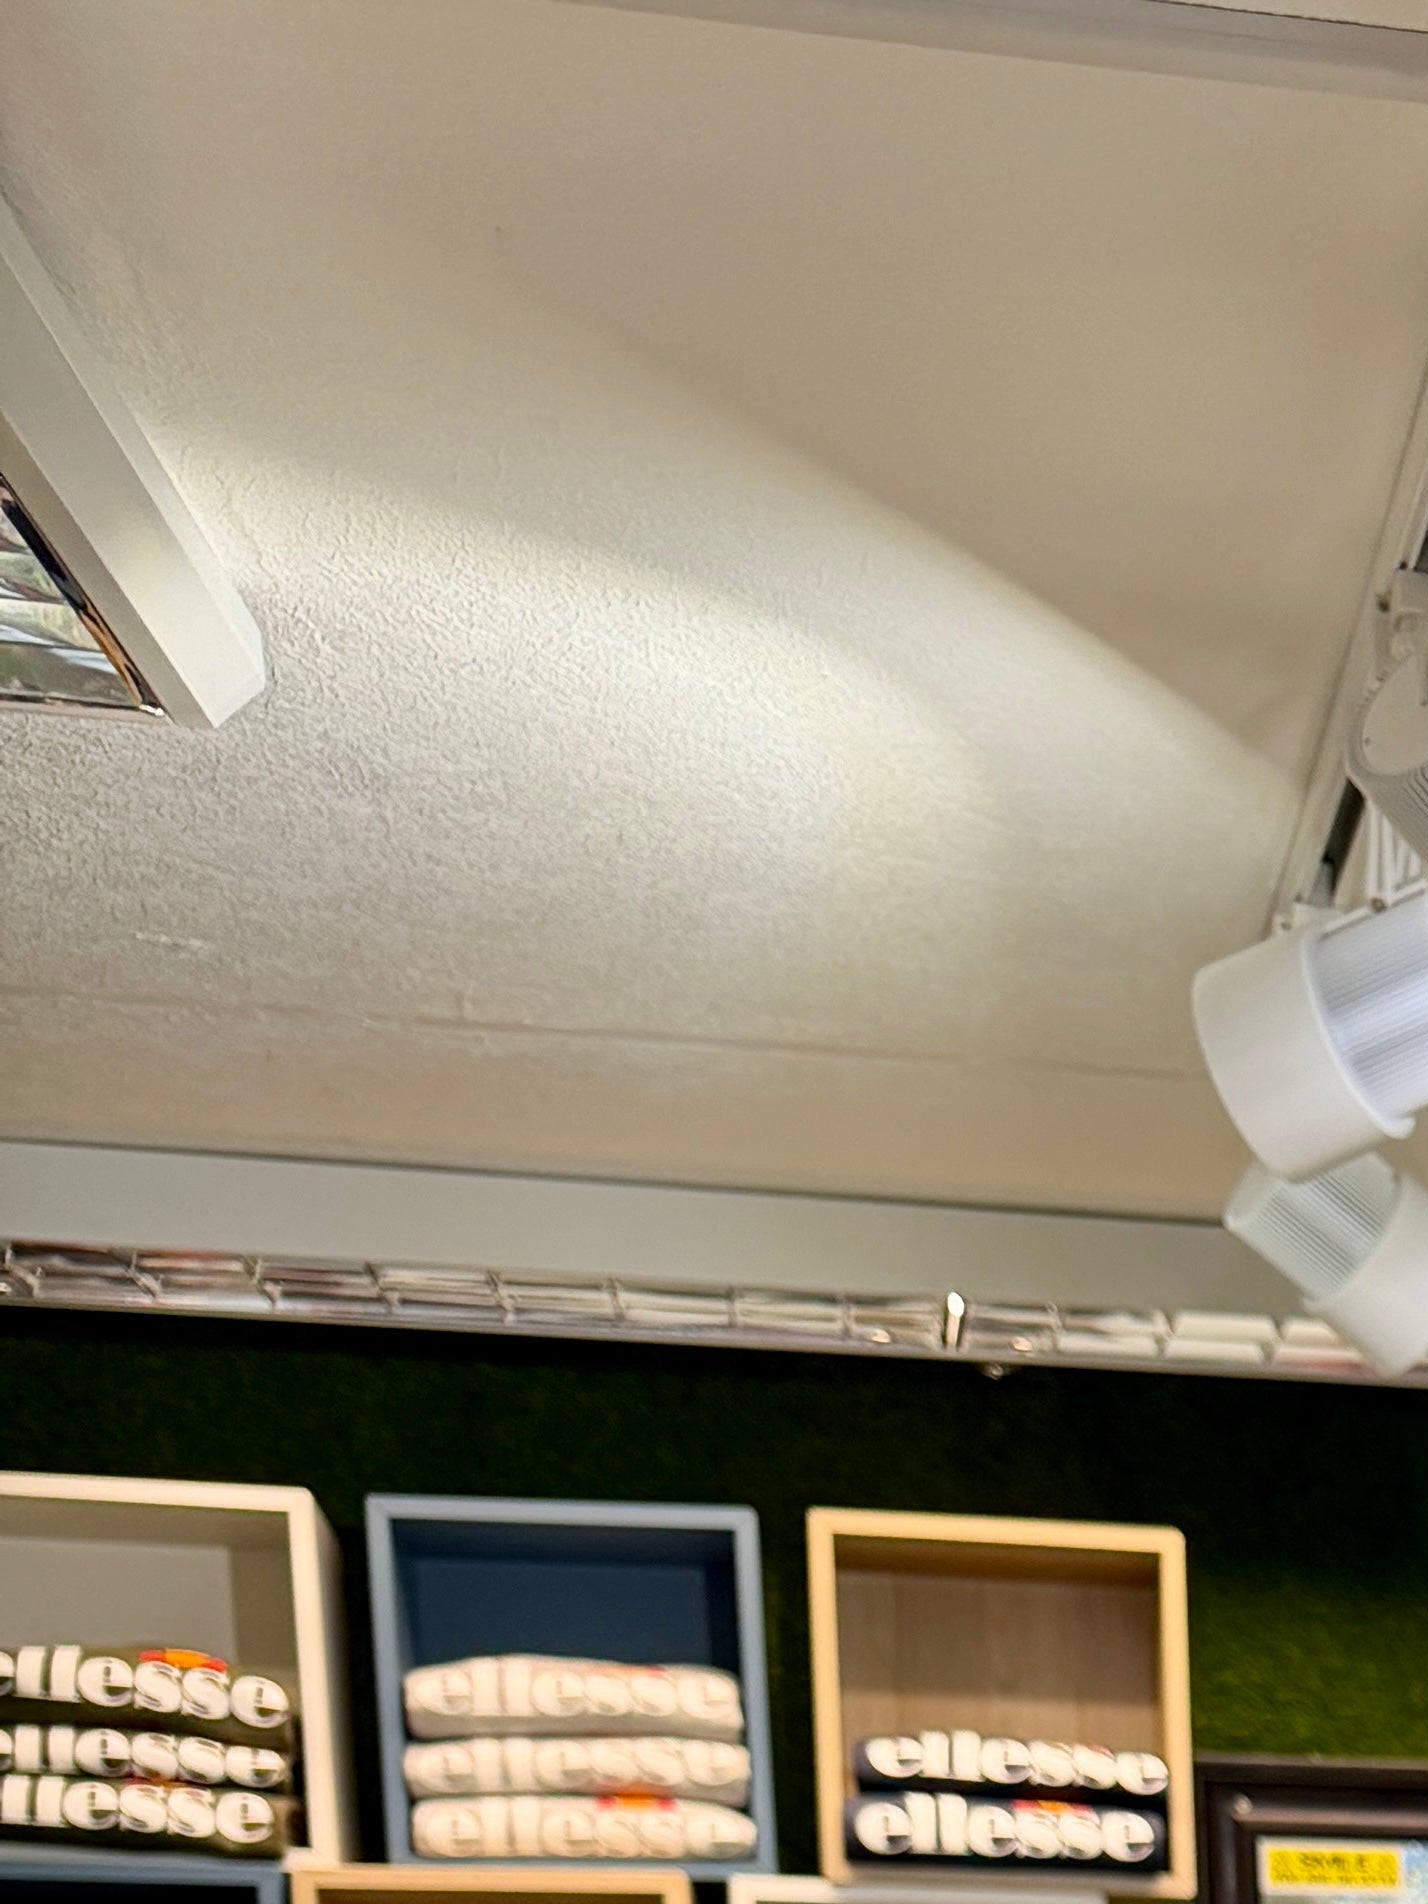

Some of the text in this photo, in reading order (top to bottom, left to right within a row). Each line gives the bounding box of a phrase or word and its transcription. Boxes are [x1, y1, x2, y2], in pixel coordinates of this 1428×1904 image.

[0, 1645, 290, 1729] llesse
[405, 1657, 741, 1722] ellesse
[0, 1723, 285, 1788] llesse
[404, 1737, 750, 1792] ellesse
[866, 1730, 1168, 1795] ellesse
[413, 1796, 757, 1858] ellesse
[855, 1792, 1155, 1862] ellesse
